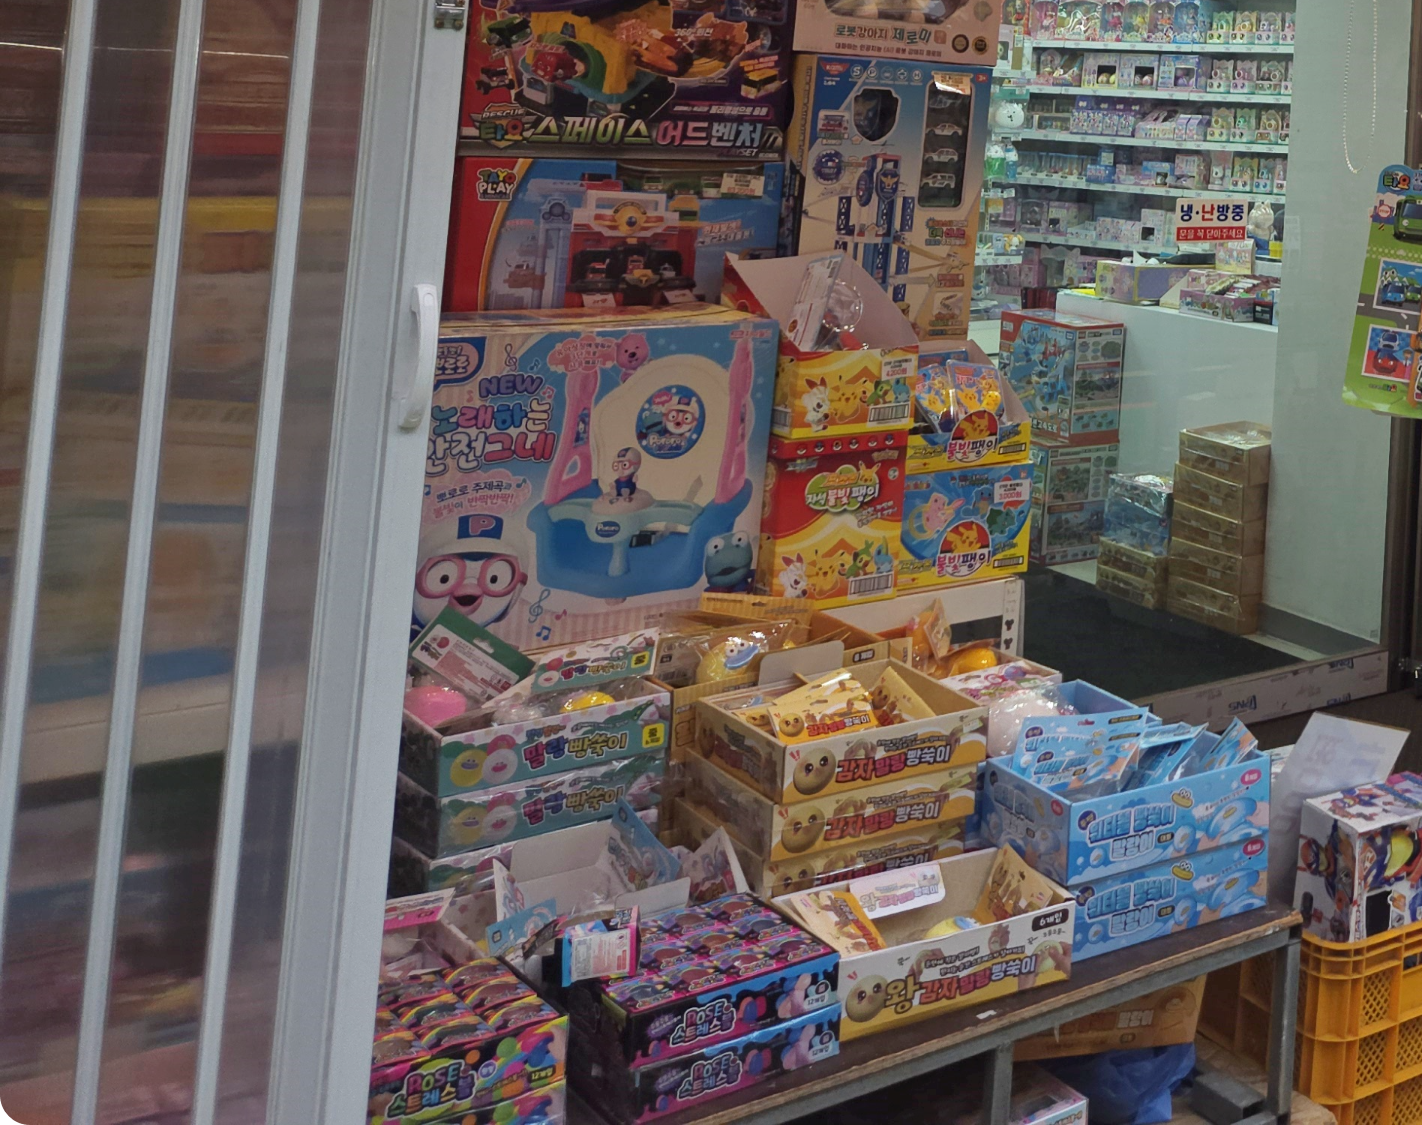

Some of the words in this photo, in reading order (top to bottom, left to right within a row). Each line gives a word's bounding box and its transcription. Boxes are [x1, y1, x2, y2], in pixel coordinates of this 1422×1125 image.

[891, 28, 932, 44] 제로미
[526, 116, 651, 145] 스페이스
[655, 120, 760, 148] 어드벤처
[476, 181, 515, 194] PLAY
[477, 169, 517, 184] TAYO
[1383, 175, 1410, 190] 타요
[1179, 229, 1195, 239] 문을
[479, 374, 544, 398] NEW
[431, 398, 550, 435] 노래하는
[467, 492, 515, 510] 반짝반짝!
[1039, 911, 1063, 927] 6개입
[686, 1001, 723, 1026] ROSE
[671, 1013, 737, 1046] 스트레스볼
[407, 1063, 461, 1092] ROSE
[692, 1053, 730, 1079] ROSE
[678, 1065, 743, 1099] 스트레스볼
[386, 1072, 477, 1118] 스트레스볼
